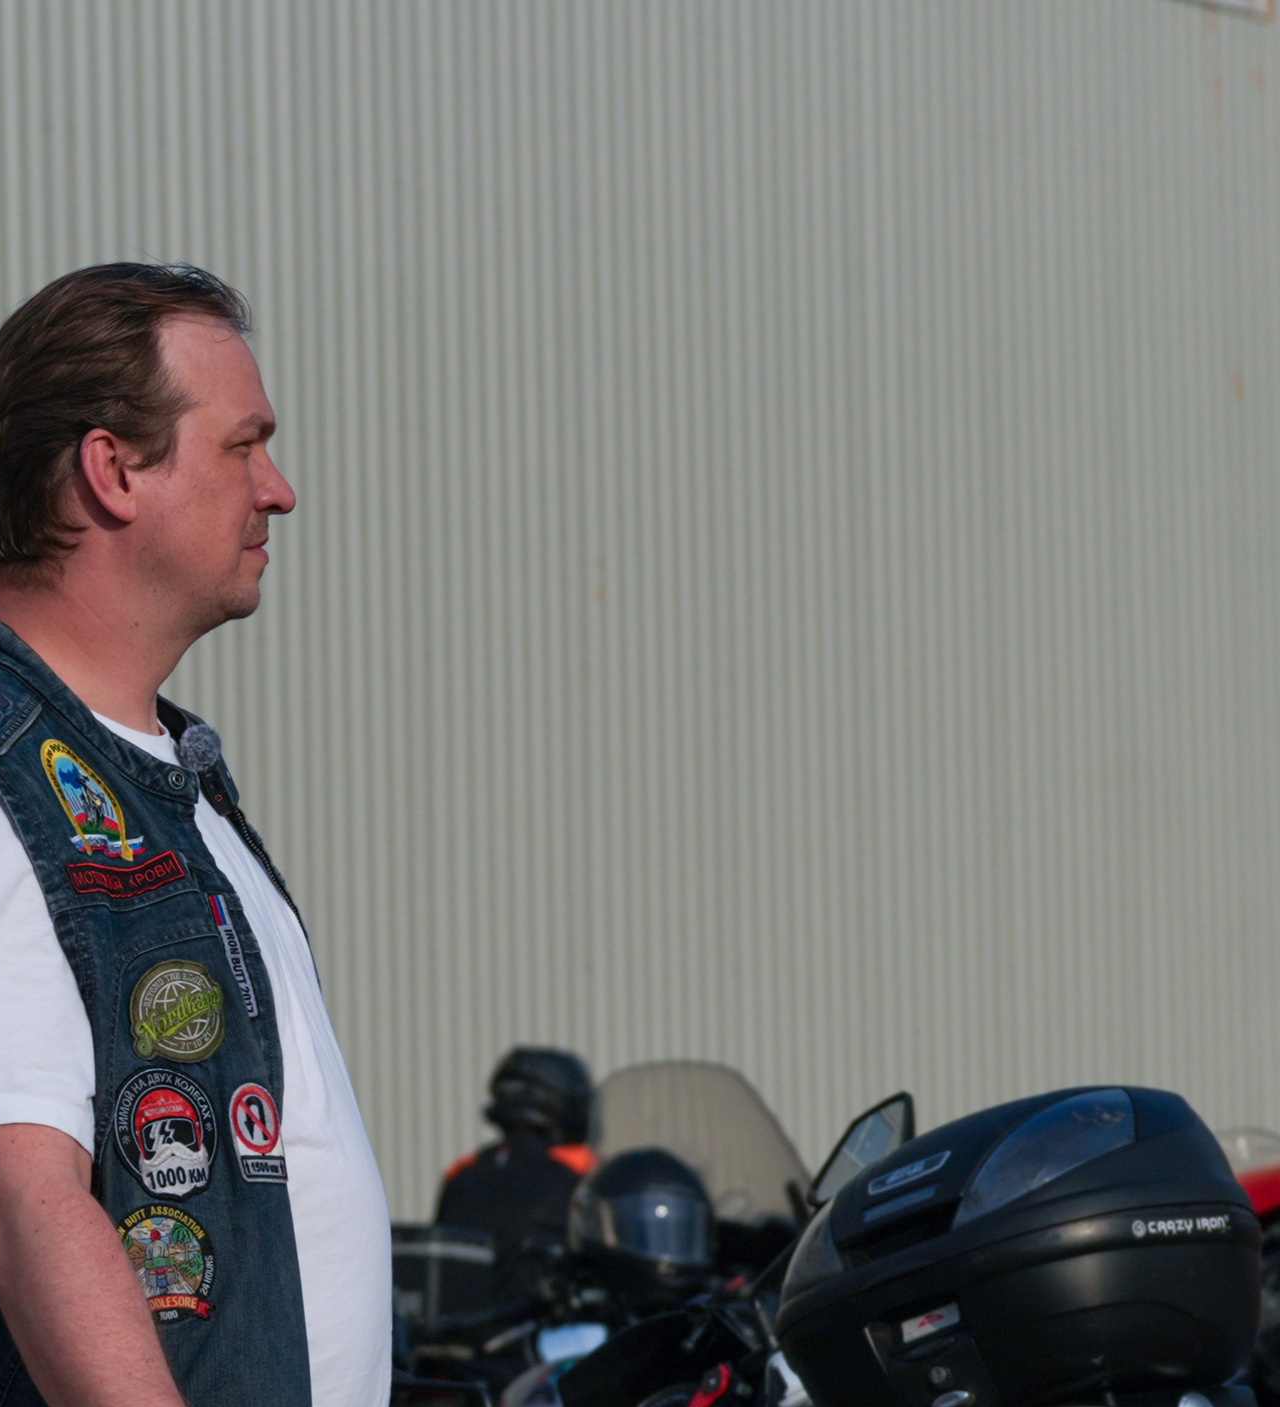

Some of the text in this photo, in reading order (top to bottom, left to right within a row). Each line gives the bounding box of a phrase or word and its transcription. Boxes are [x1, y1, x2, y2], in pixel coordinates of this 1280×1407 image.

[224, 929, 239, 955] IRON
[231, 957, 247, 985] BUTT
[144, 978, 164, 1008] BEYOND
[118, 1072, 212, 1132] ЗИМОЙ НА ДВУХ КОЛЕСАХ
[147, 1166, 186, 1189] 1000
[124, 1208, 146, 1226] BUTT
[150, 1206, 205, 1239] ASSOCIATION
[1148, 1219, 1194, 1236] CRAZY
[149, 1296, 198, 1309] DDLESORE
[200, 1283, 210, 1296] 24
